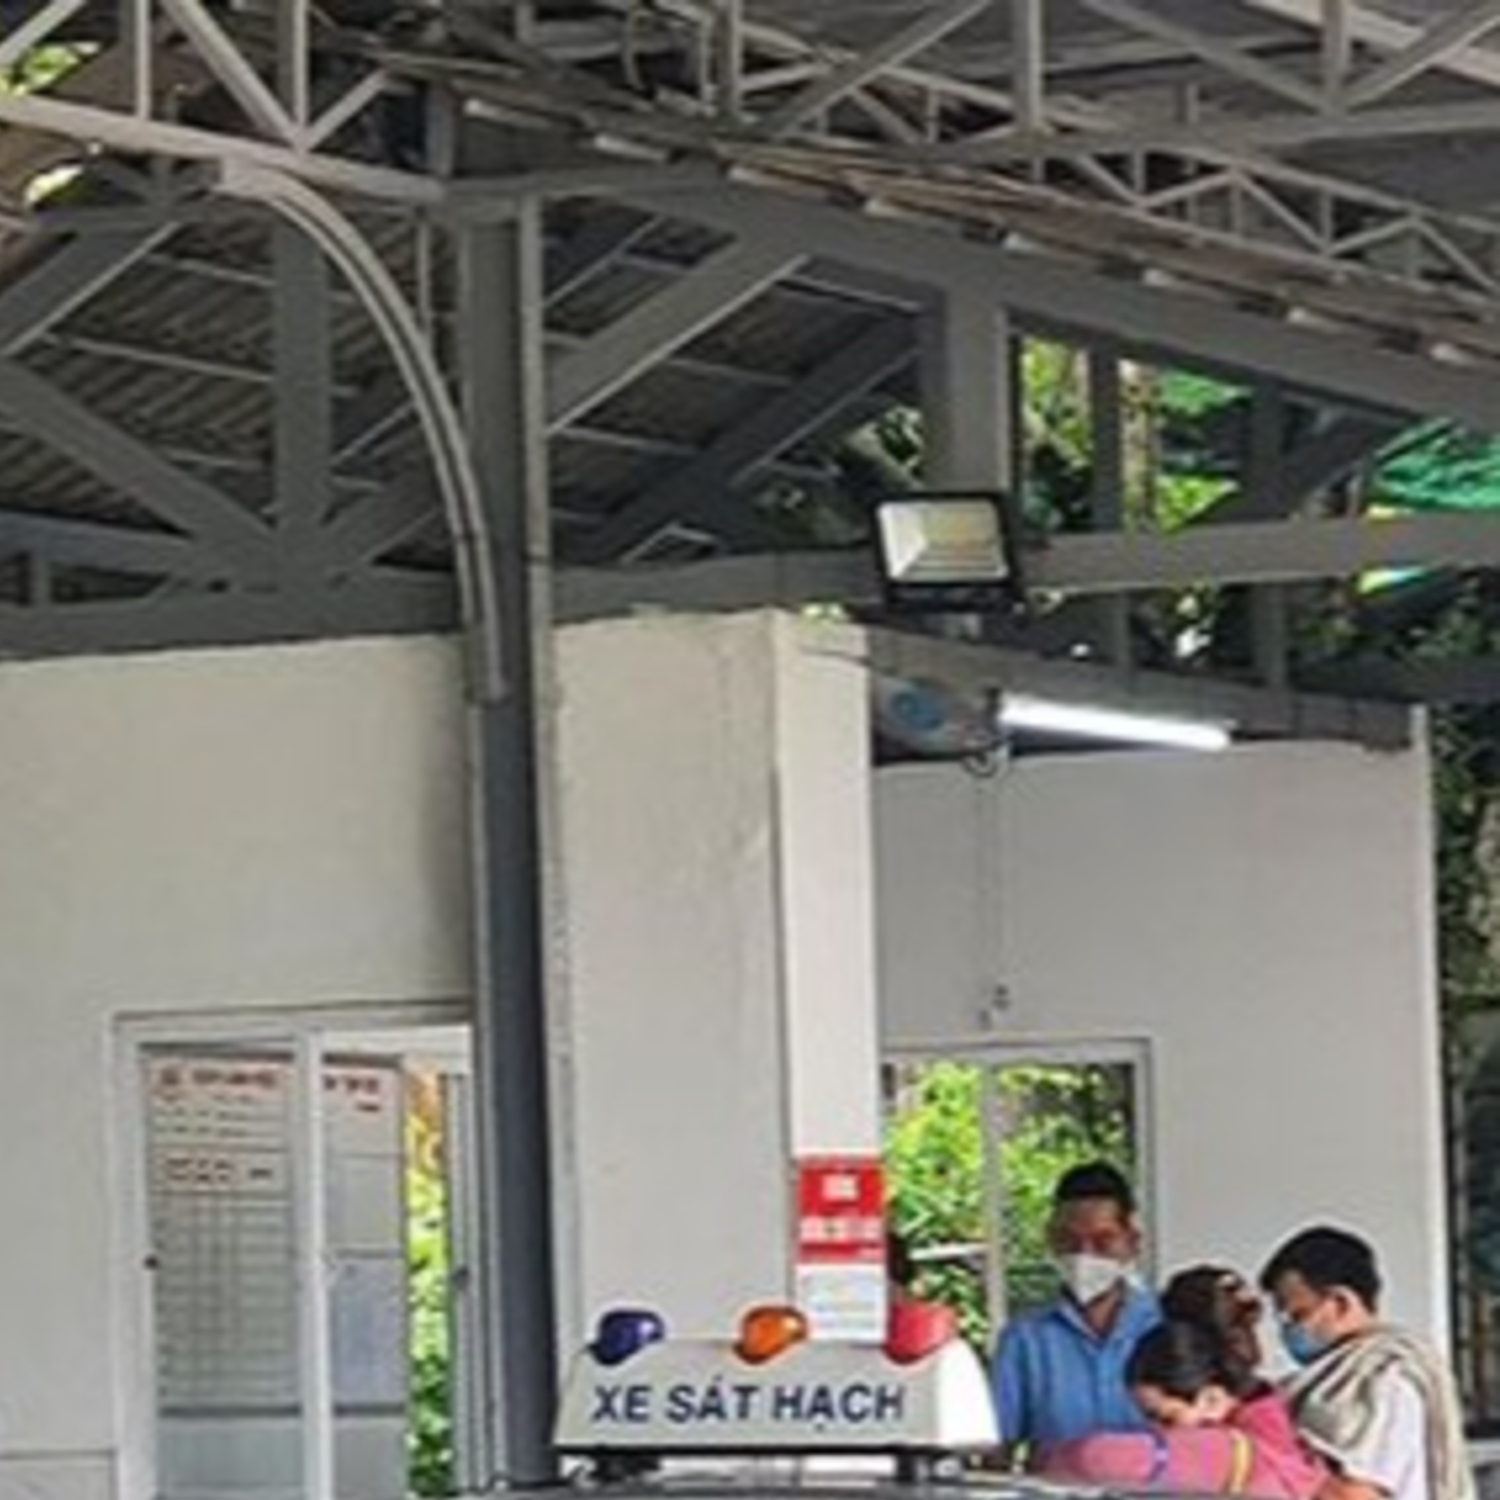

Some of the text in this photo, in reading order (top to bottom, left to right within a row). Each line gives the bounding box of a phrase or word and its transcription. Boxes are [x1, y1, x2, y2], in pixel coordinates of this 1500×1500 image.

[592, 1374, 906, 1432] XE SÁT HẠCH
